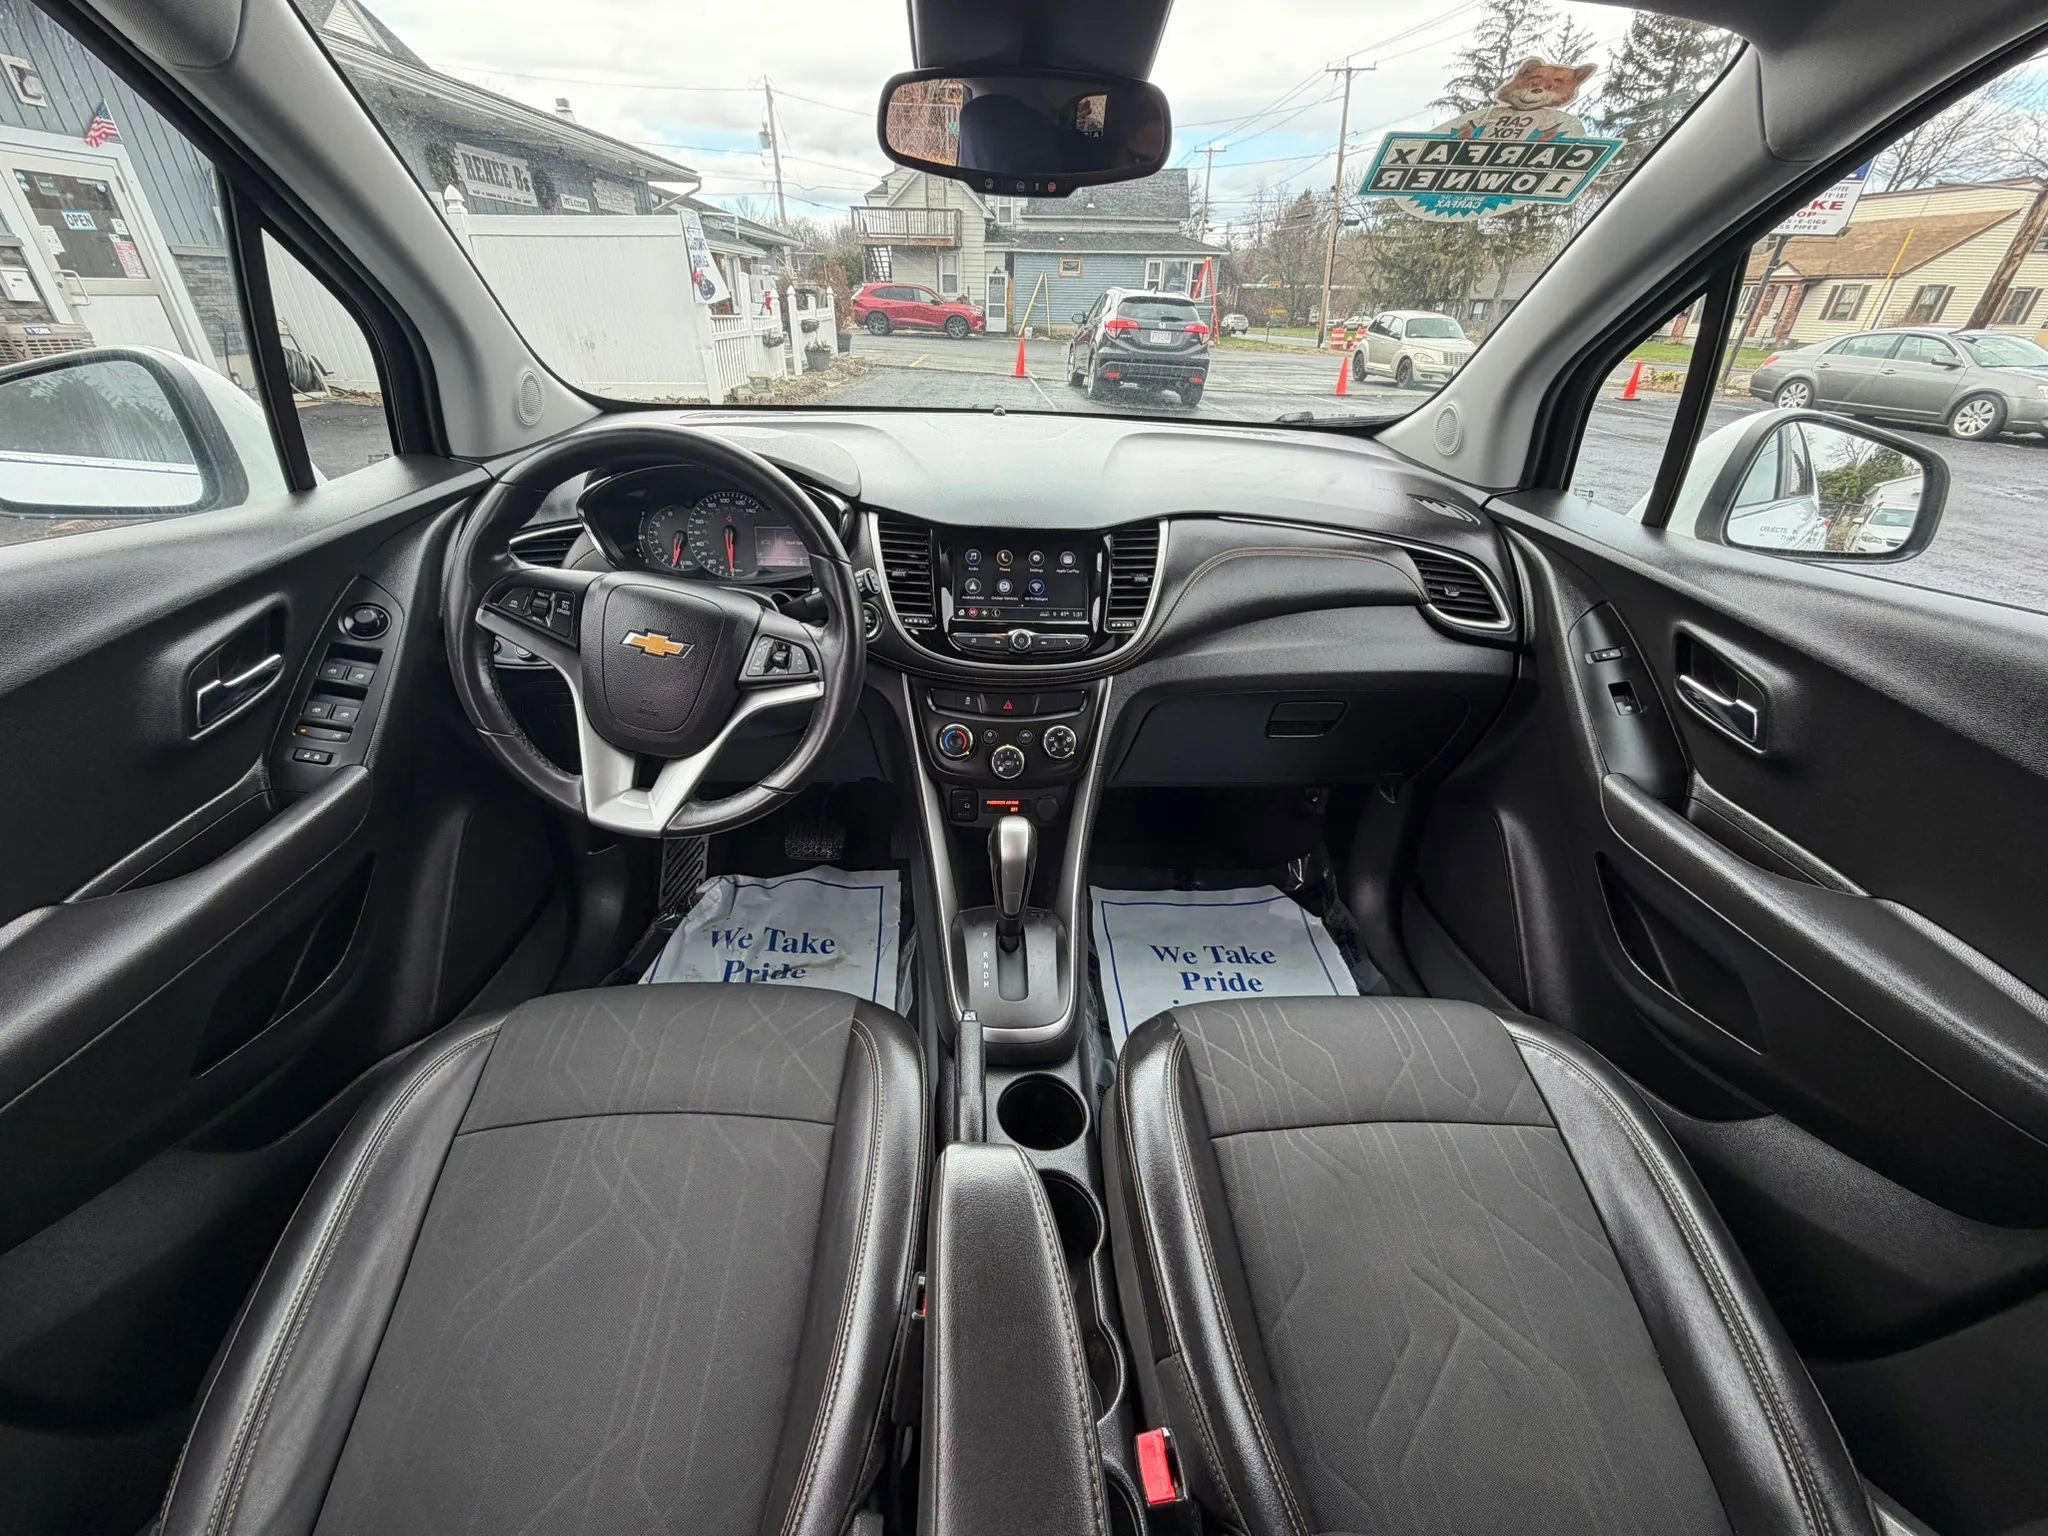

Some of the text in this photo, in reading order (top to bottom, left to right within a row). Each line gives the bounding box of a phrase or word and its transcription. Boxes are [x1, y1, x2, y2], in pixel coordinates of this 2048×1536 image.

[461, 152, 513, 189] RENEE
[563, 196, 589, 211] WELCOME
[66, 214, 95, 228] OPEN
[711, 927, 836, 954] We Take
[1148, 944, 1277, 966] We Take
[723, 959, 807, 983] Pride
[1179, 971, 1265, 993] Pride
